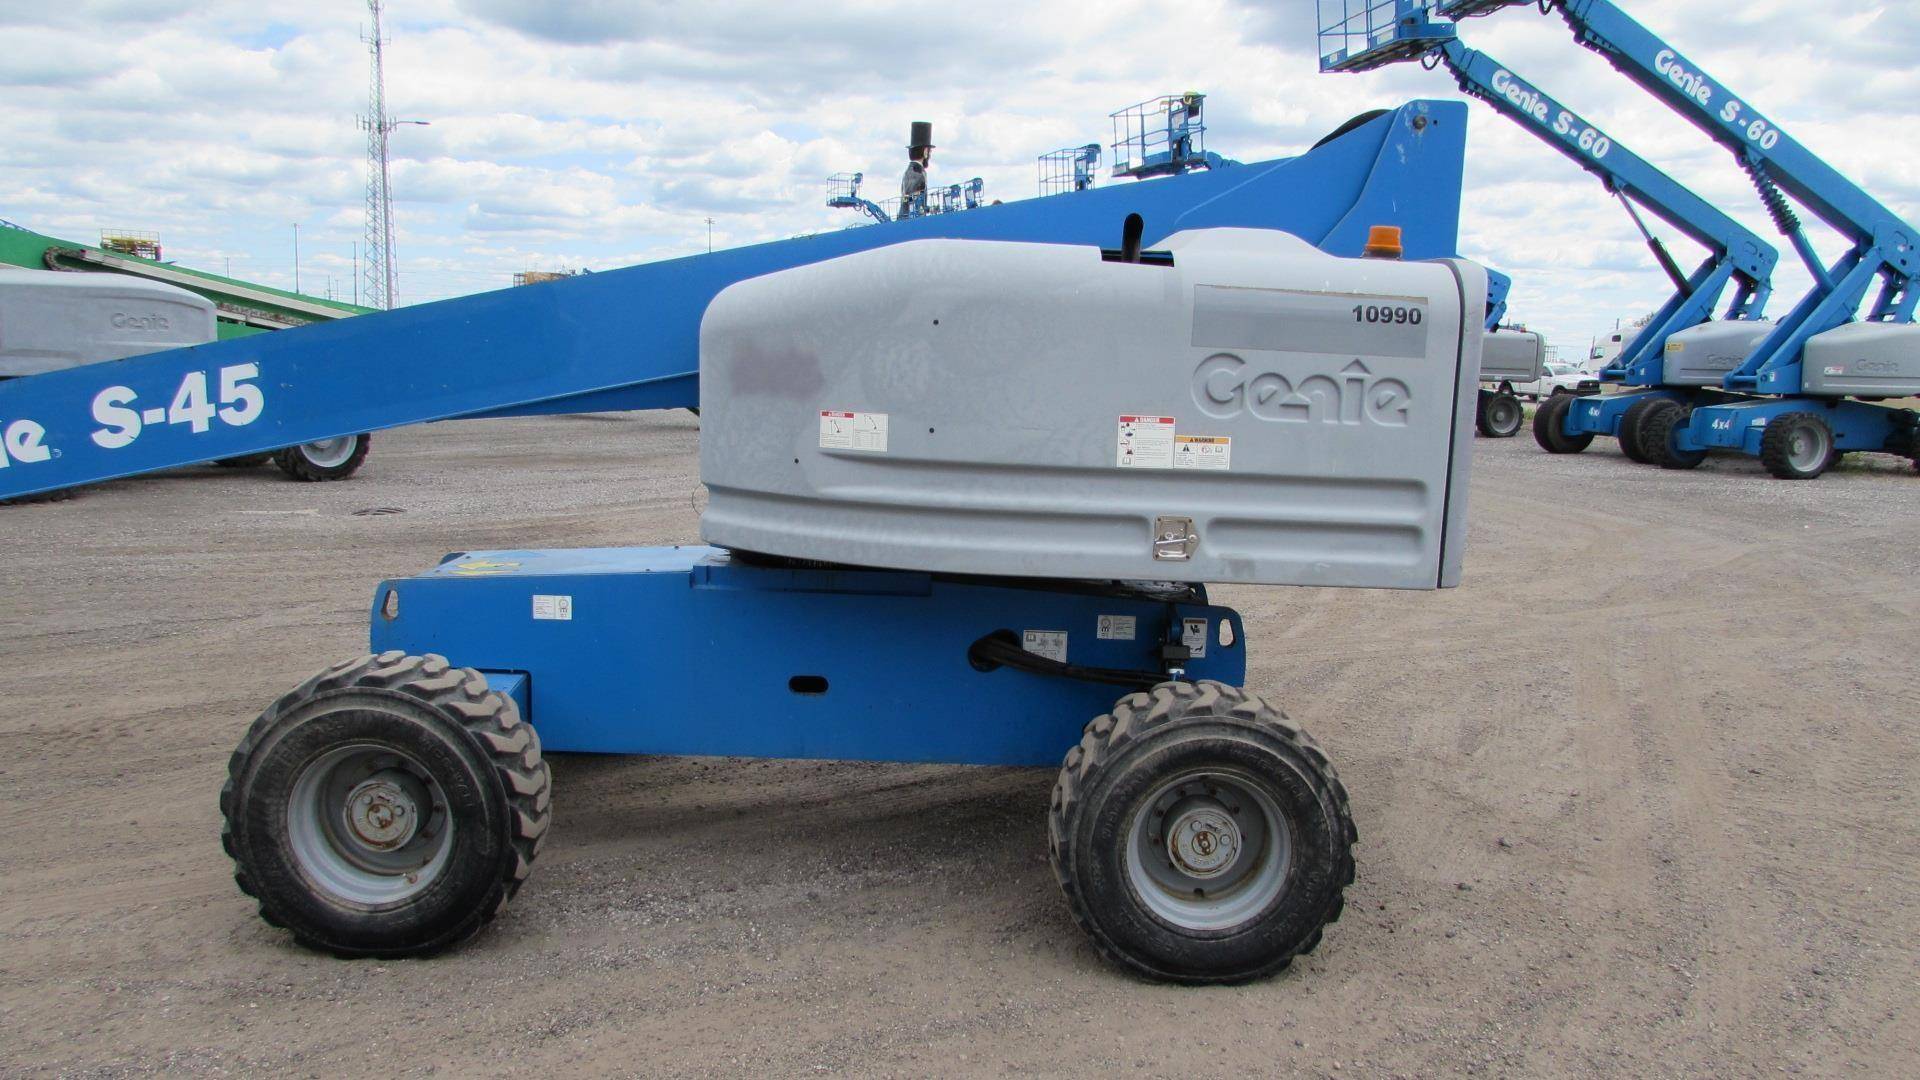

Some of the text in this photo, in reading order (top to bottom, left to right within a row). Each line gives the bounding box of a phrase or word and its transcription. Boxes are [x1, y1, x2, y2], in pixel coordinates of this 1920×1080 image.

[1491, 69, 1610, 159] Genie S-60
[1654, 49, 1778, 150] Genie S-60
[110, 312, 169, 331] Genie
[1352, 304, 1422, 326] 10990
[91, 361, 265, 449] S-45
[1190, 352, 1412, 427] Genie
[1711, 418, 1731, 430] 4x4
